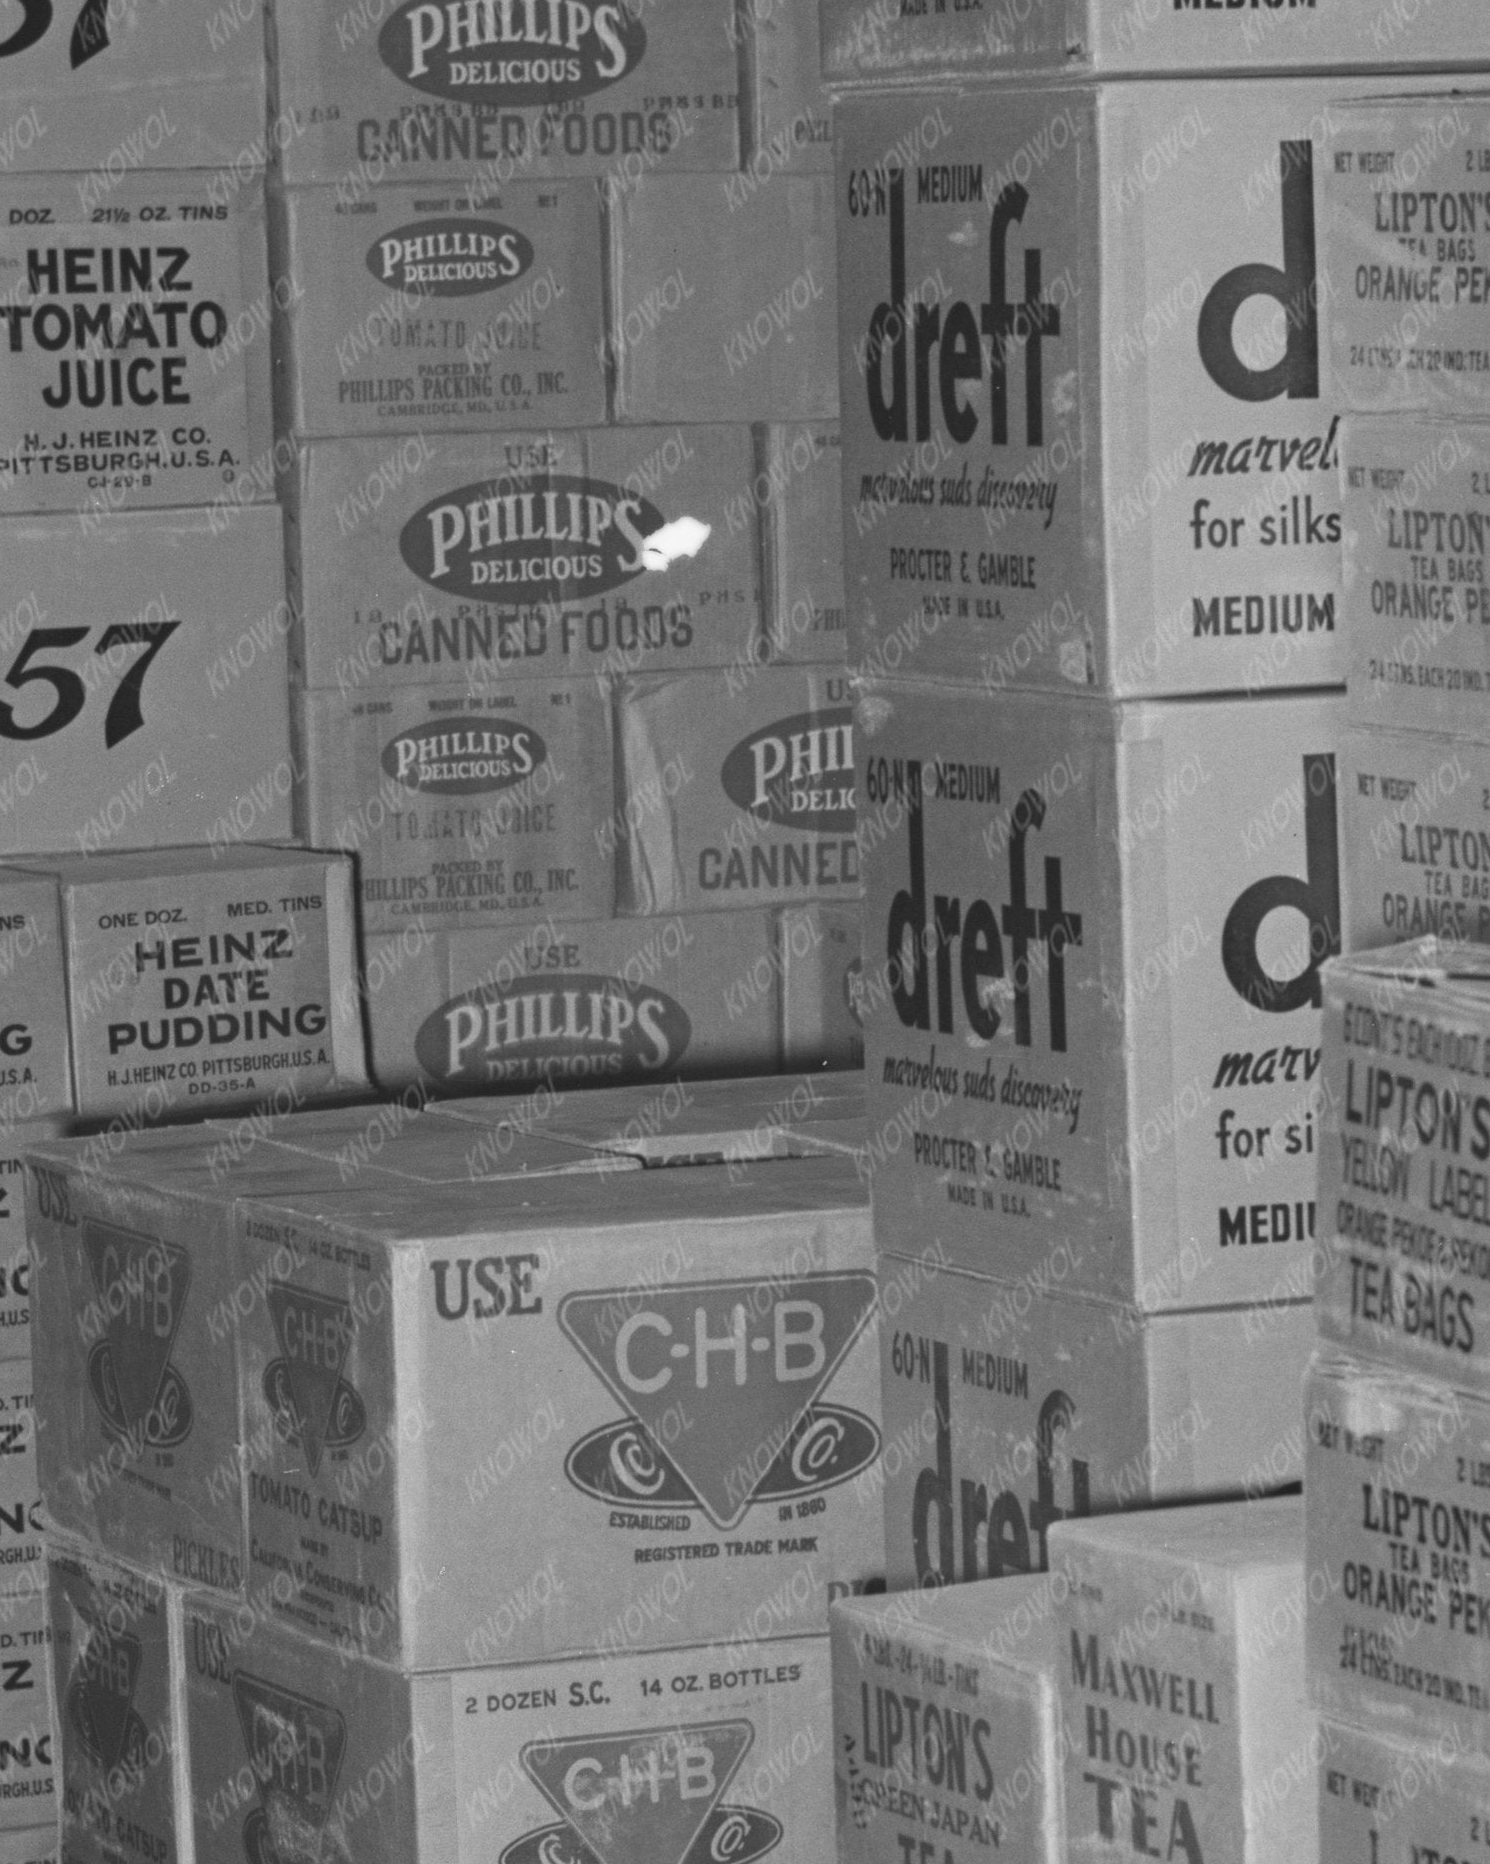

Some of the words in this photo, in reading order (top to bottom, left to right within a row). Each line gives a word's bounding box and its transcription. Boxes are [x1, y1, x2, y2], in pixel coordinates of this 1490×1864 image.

[448, 57, 582, 85] DELICIOUS
[356, 117, 527, 164] CANNED
[538, 113, 673, 155] FOODS
[338, 376, 416, 404] PHILLIPS
[422, 374, 495, 402] PACKING
[164, 970, 269, 1009] DATE
[429, 1253, 544, 1321] USE
[609, 1511, 690, 1531] ESTABLISHED
[634, 1543, 719, 1563] REGISTERED
[725, 1540, 772, 1556] TRADE
[778, 1537, 817, 1553] MARK
[466, 1697, 477, 1714] 2
[487, 1689, 556, 1712] DOZEN
[569, 1680, 610, 1707] S.C.
[641, 1679, 662, 1696] 14
[671, 1675, 703, 1693] OZ.
[709, 1665, 801, 1690] BOTTLES
[1070, 1629, 1220, 1726] MAXWELL
